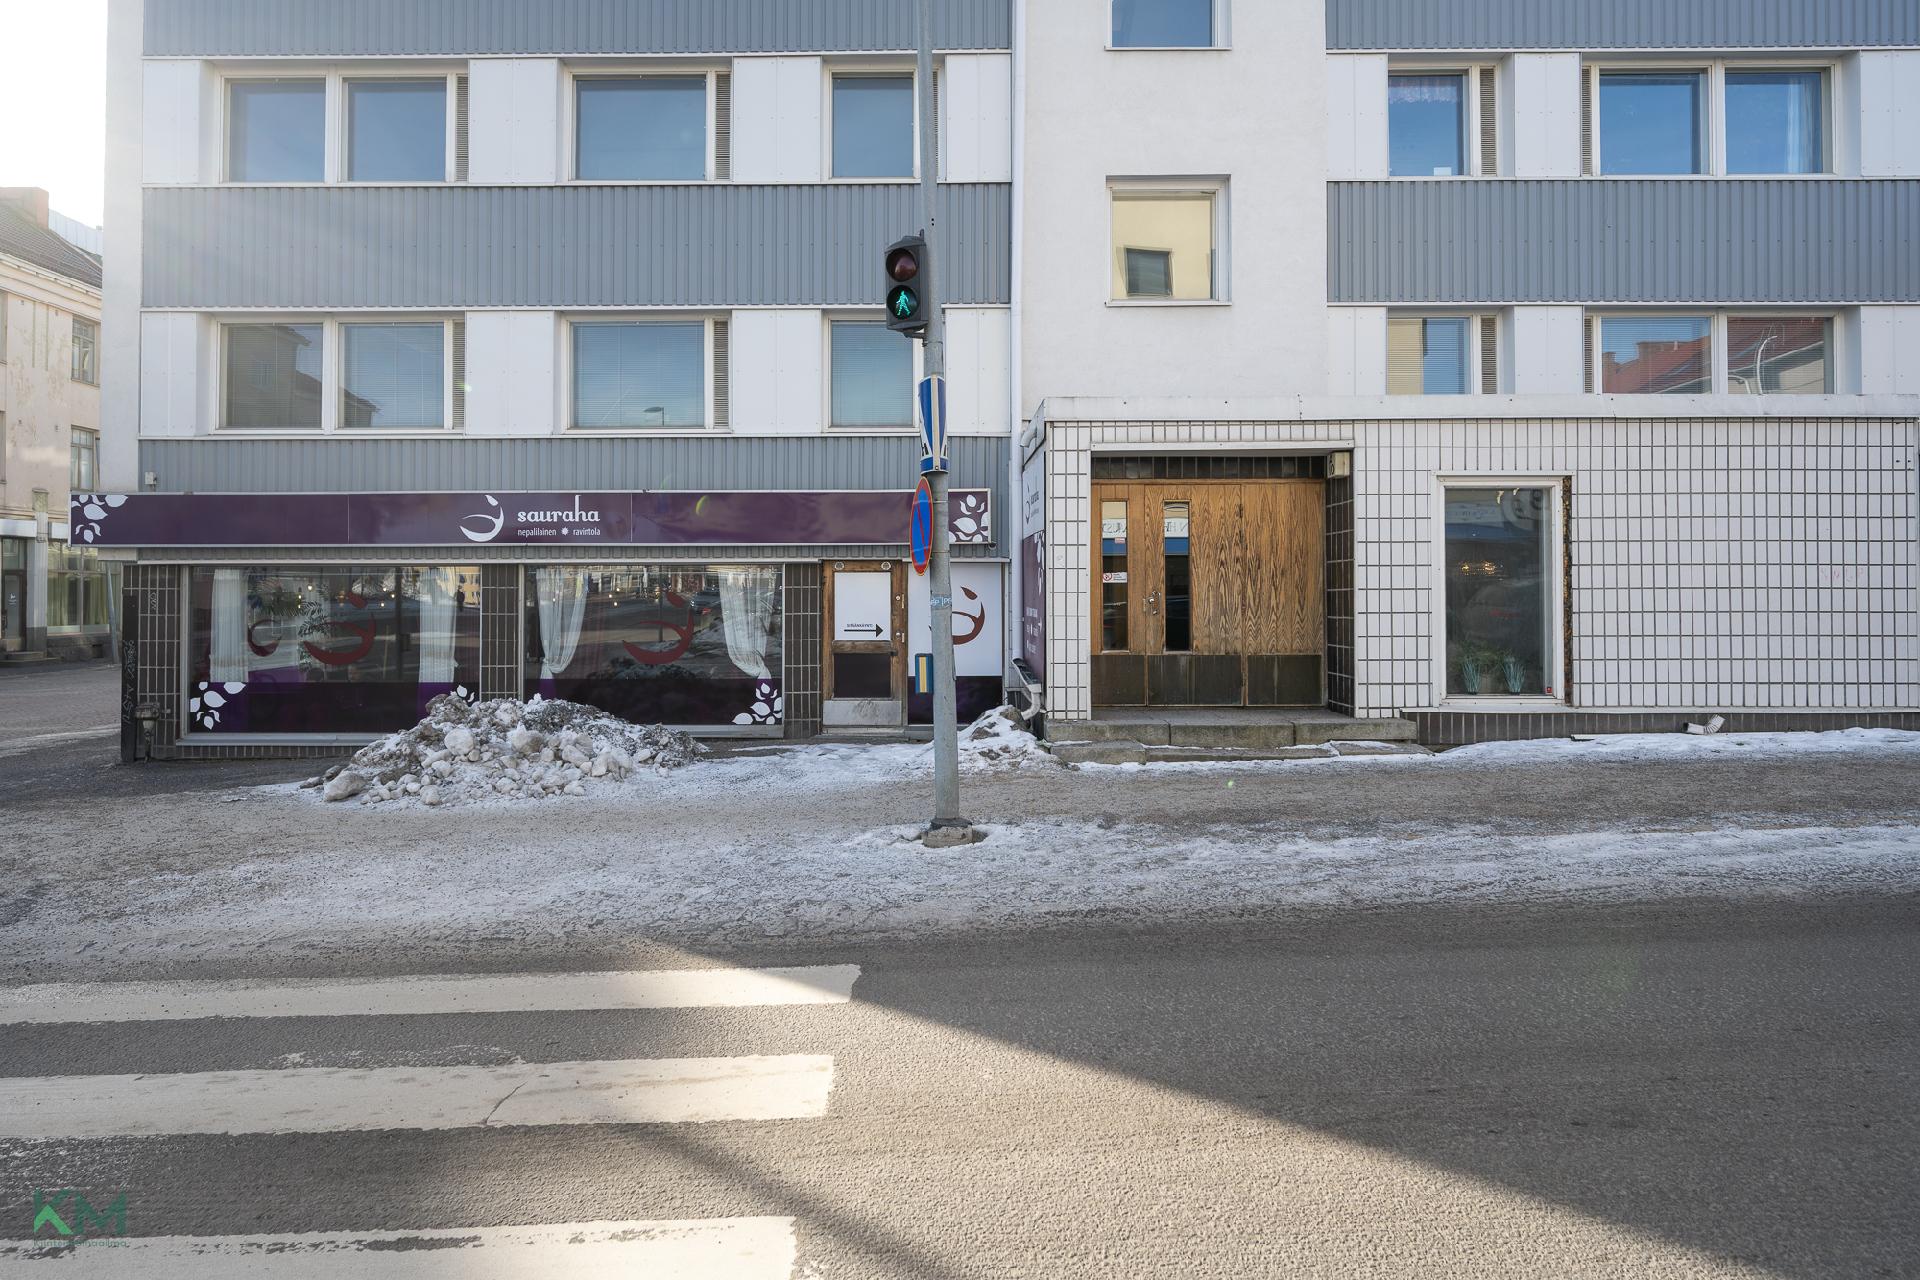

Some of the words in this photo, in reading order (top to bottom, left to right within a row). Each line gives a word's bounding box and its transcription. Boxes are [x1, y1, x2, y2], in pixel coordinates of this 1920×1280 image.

[517, 494, 601, 522] sauraha
[517, 527, 557, 537] nepalilainen
[573, 527, 601, 536] ravintola
